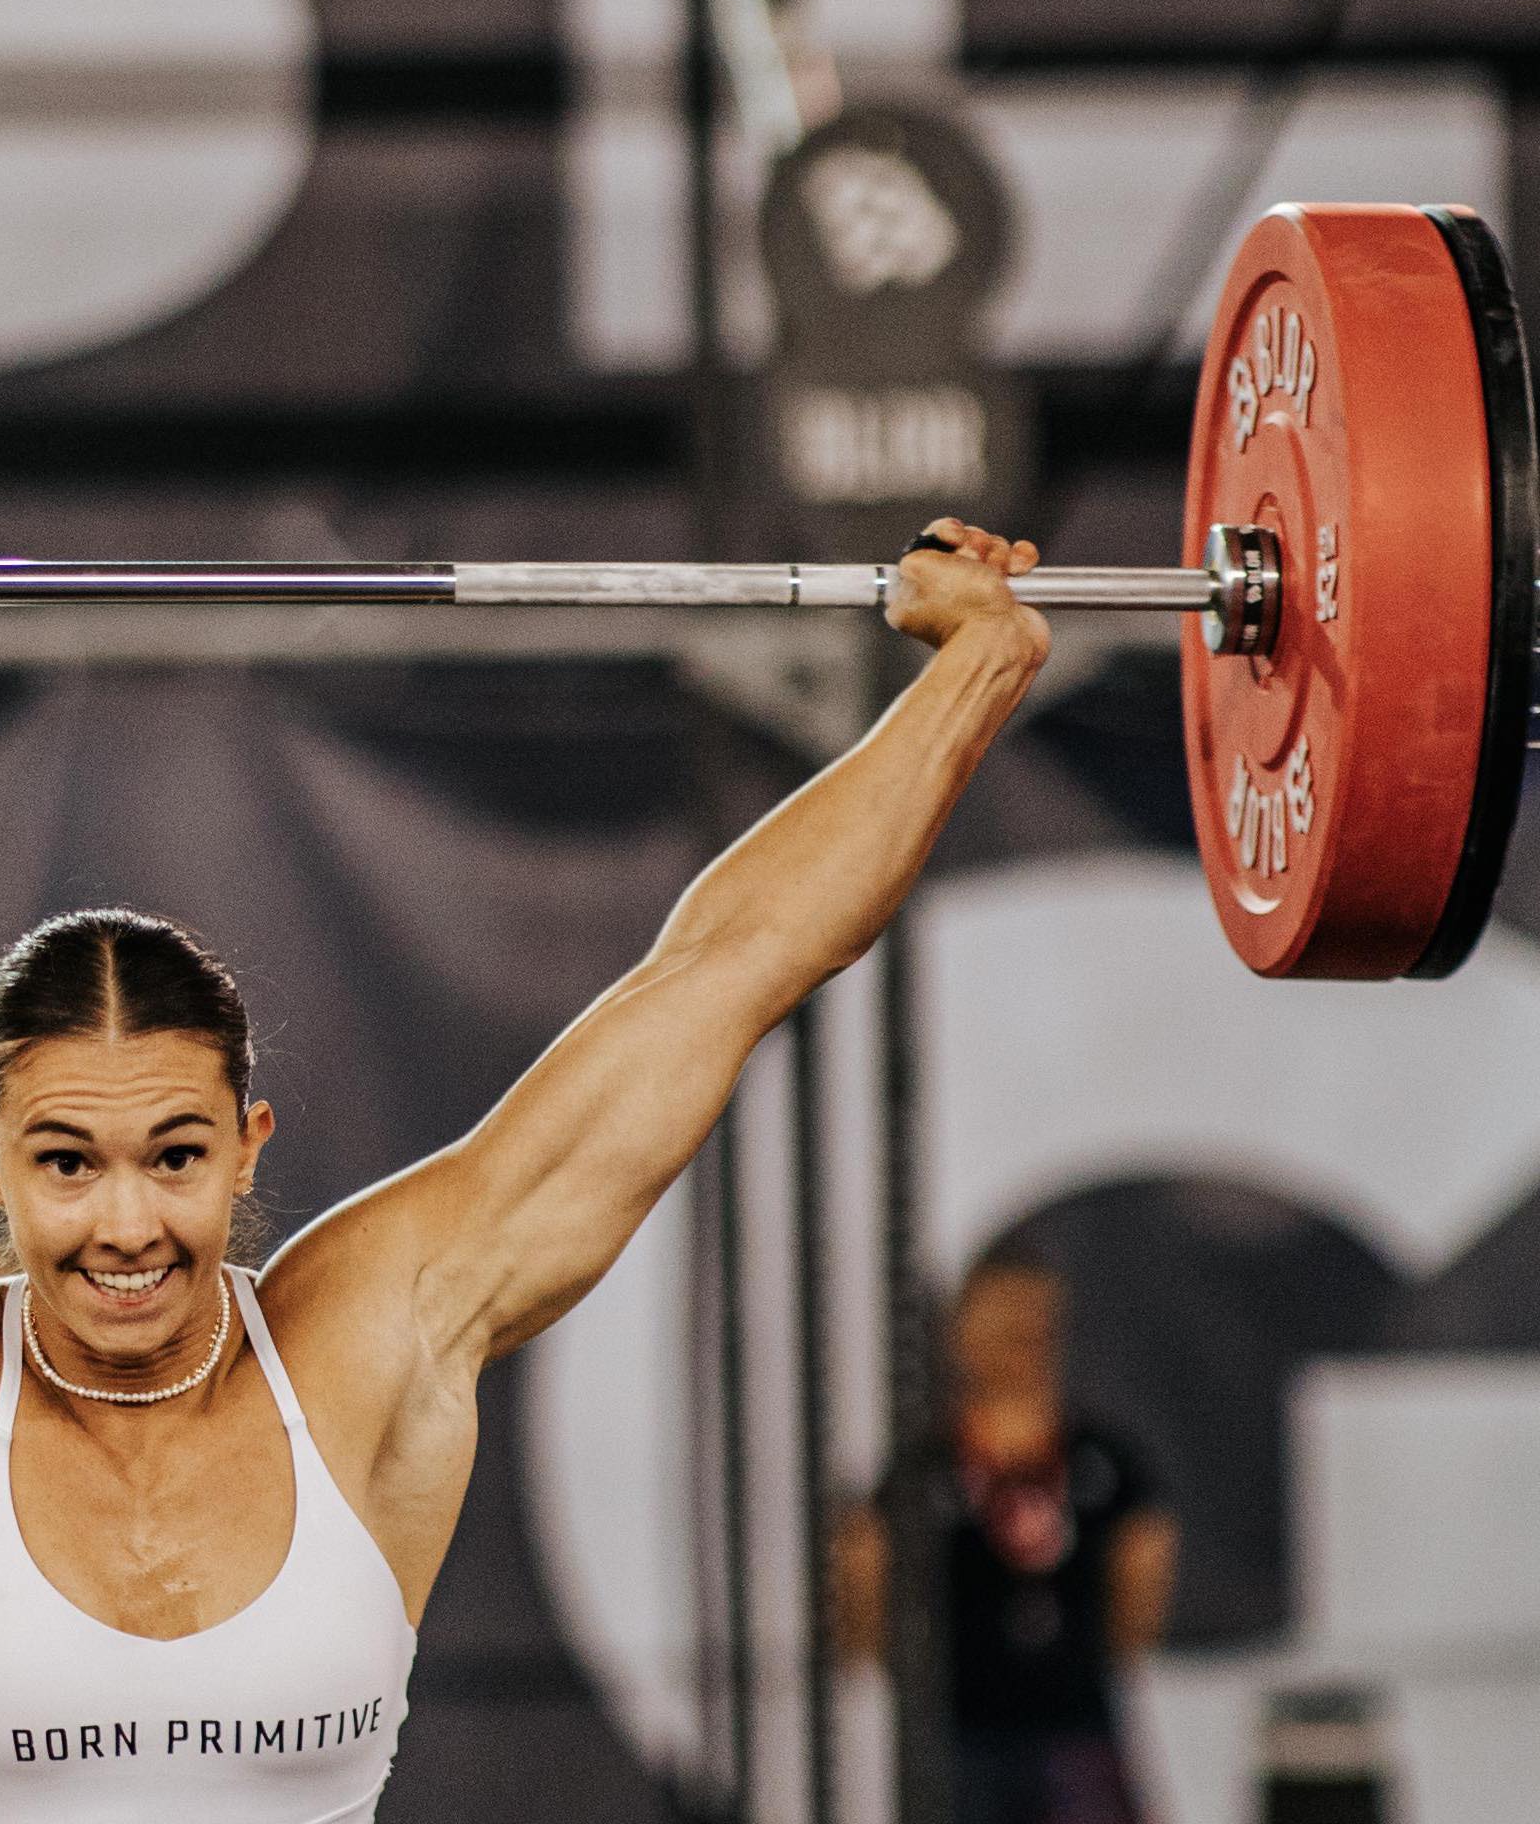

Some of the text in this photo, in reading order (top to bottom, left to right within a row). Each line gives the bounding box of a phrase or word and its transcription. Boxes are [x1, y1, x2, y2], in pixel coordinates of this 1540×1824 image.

[1255, 305, 1316, 428] BLOR
[1227, 752, 1288, 879] BLOR
[11, 1696, 382, 1762] BORN PRIMITIVE
